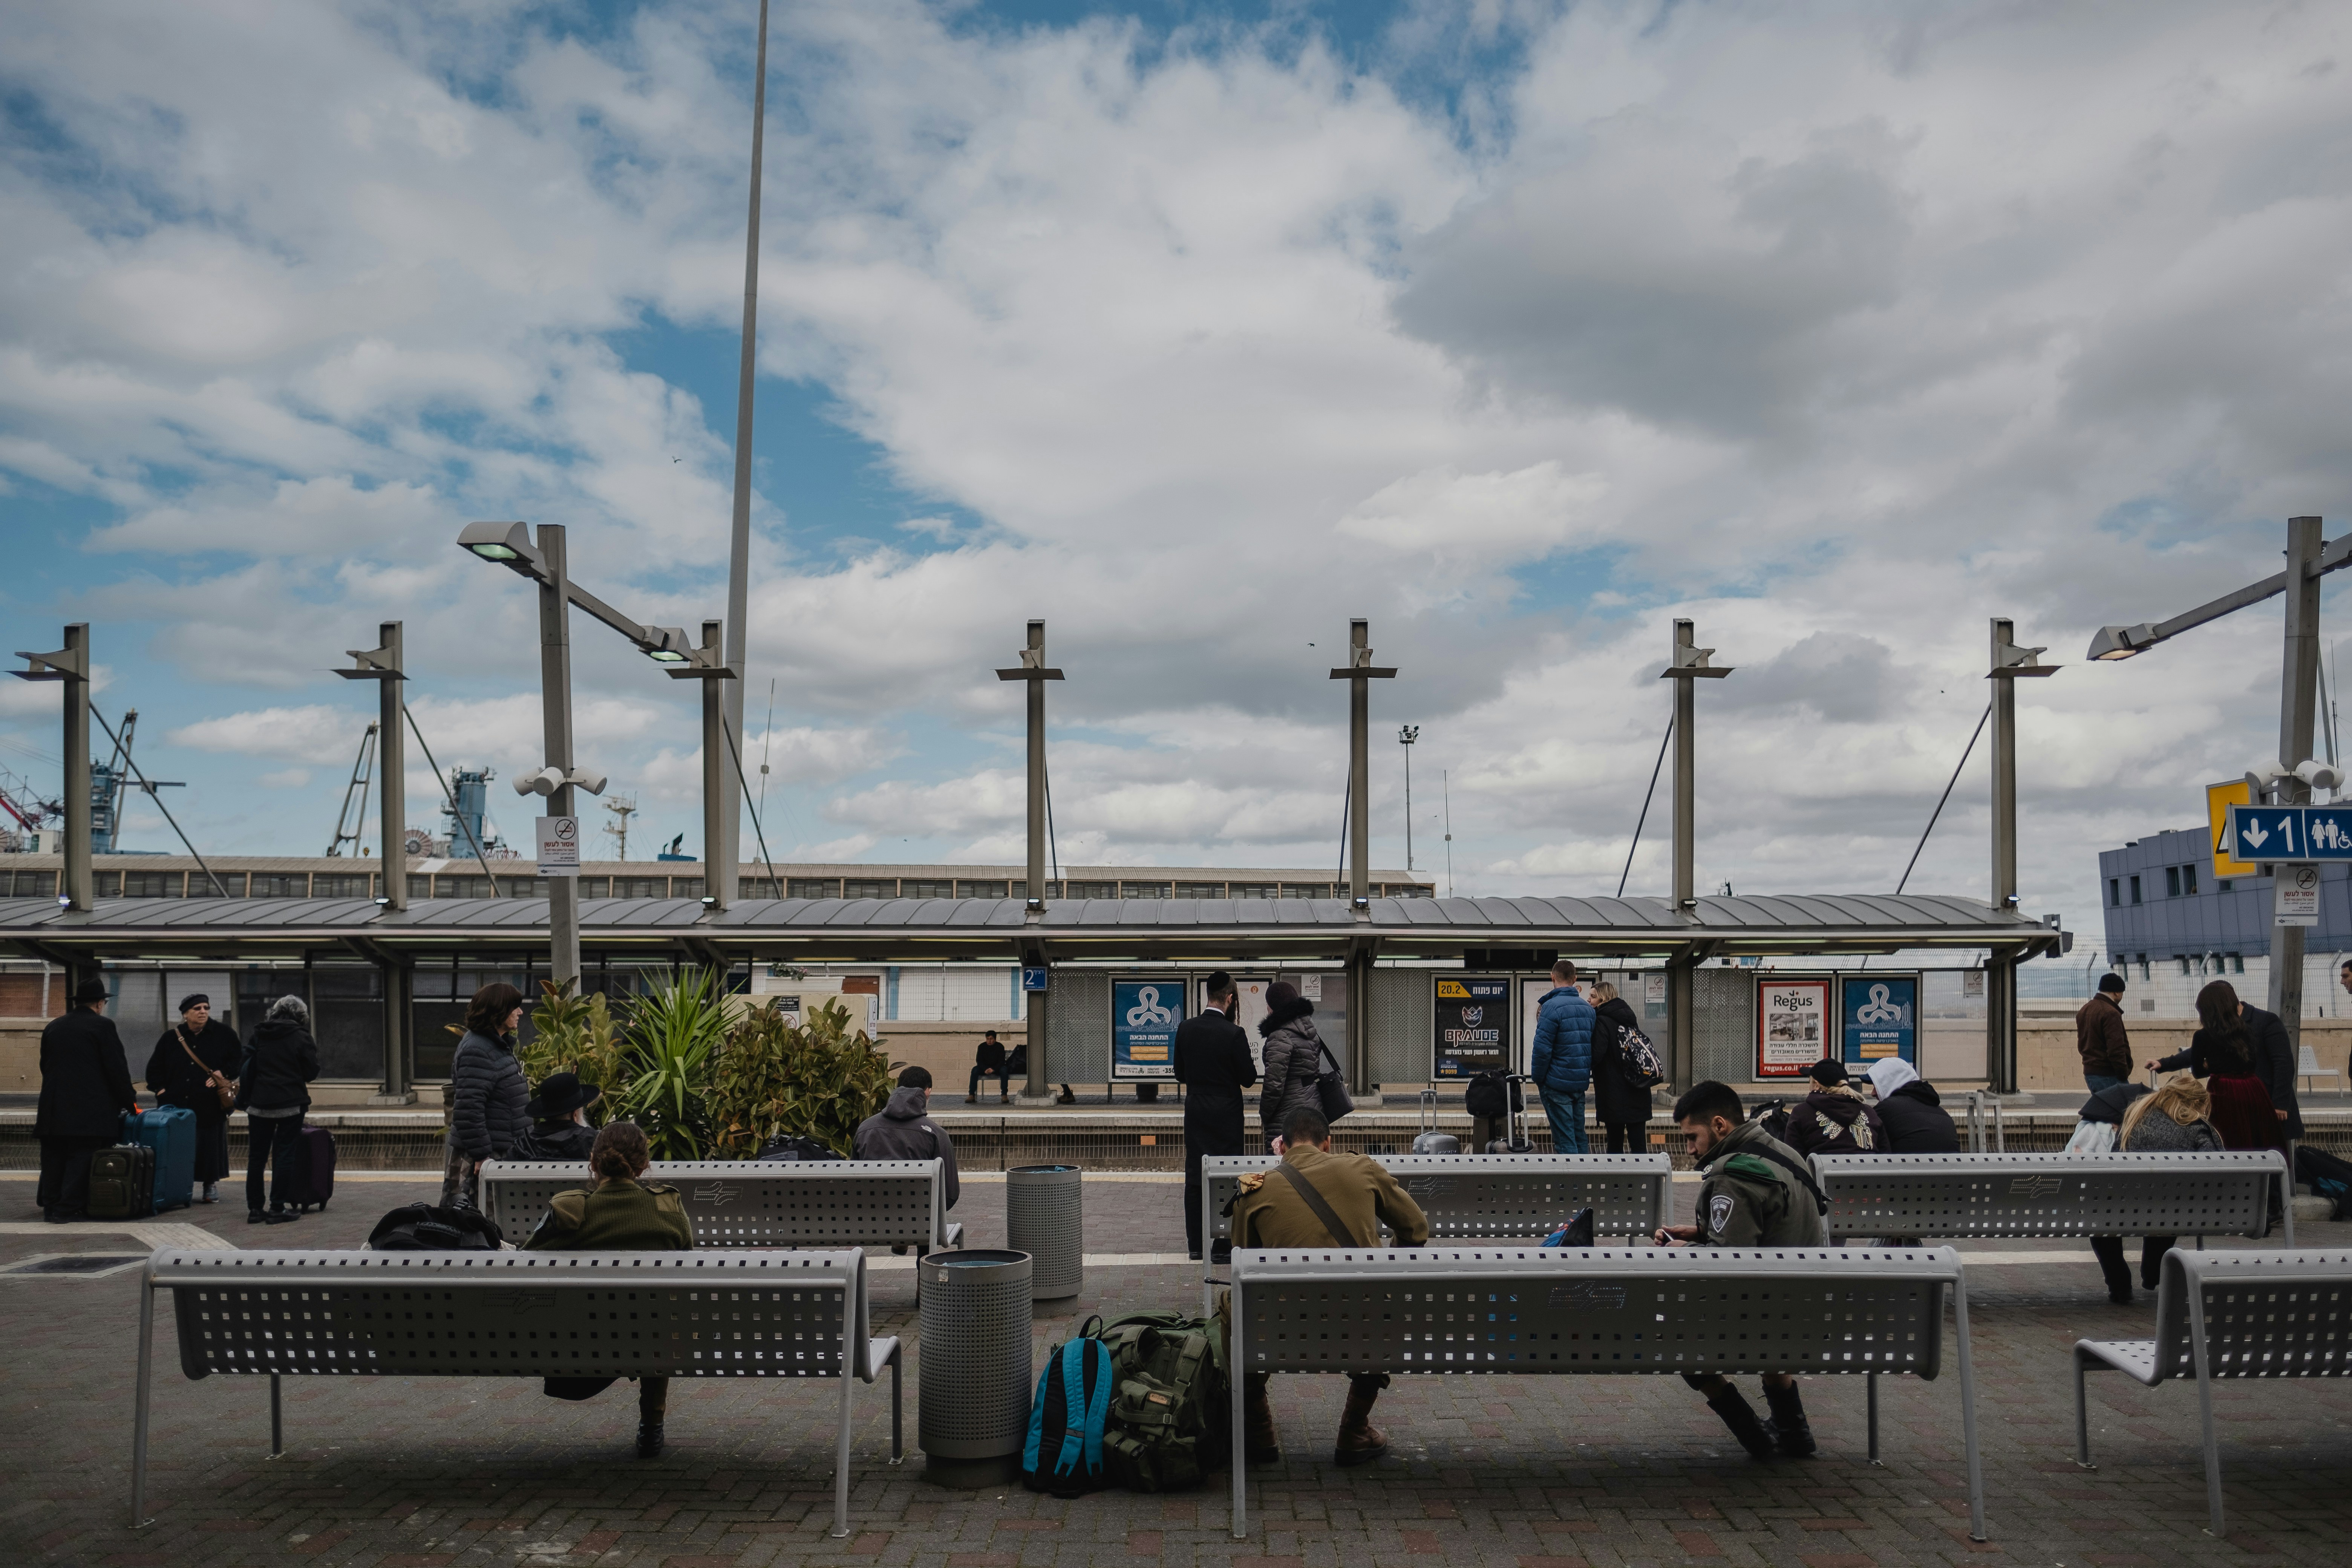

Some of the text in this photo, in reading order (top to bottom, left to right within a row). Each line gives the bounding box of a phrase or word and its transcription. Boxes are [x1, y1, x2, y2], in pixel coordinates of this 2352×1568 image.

[2278, 816, 2294, 852] 1
[1026, 970, 1034, 985] 2
[1441, 985, 1461, 994] 20.2
[1774, 995, 1813, 1011] Regus
[1445, 1029, 1499, 1047] BRAUDE
